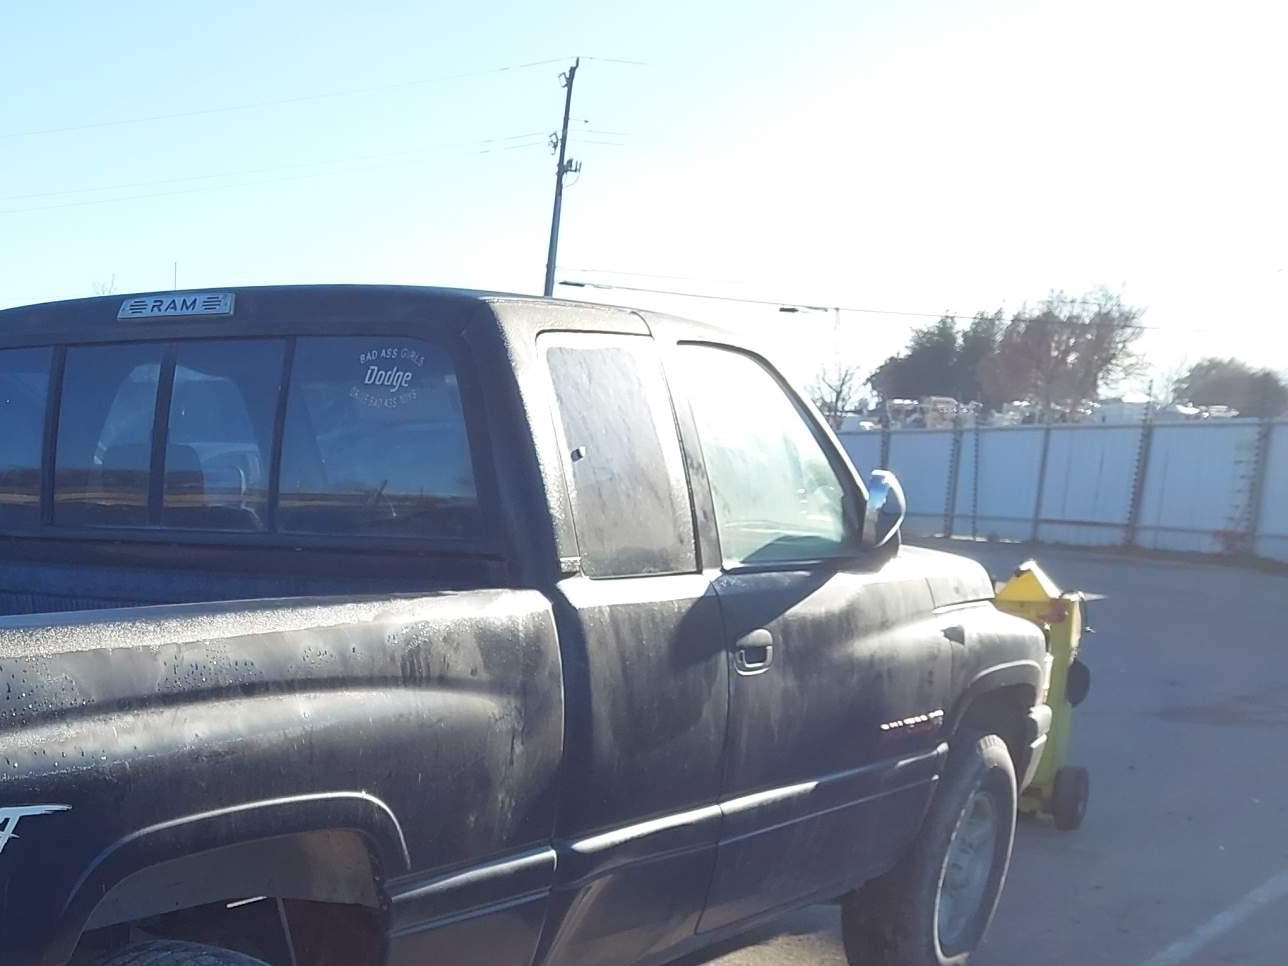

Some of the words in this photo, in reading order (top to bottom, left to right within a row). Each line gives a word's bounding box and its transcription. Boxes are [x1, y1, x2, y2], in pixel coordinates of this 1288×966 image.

[150, 298, 198, 313] RAM
[360, 350, 378, 364] BAD
[380, 348, 398, 359] ASS
[364, 365, 413, 392] Dodge
